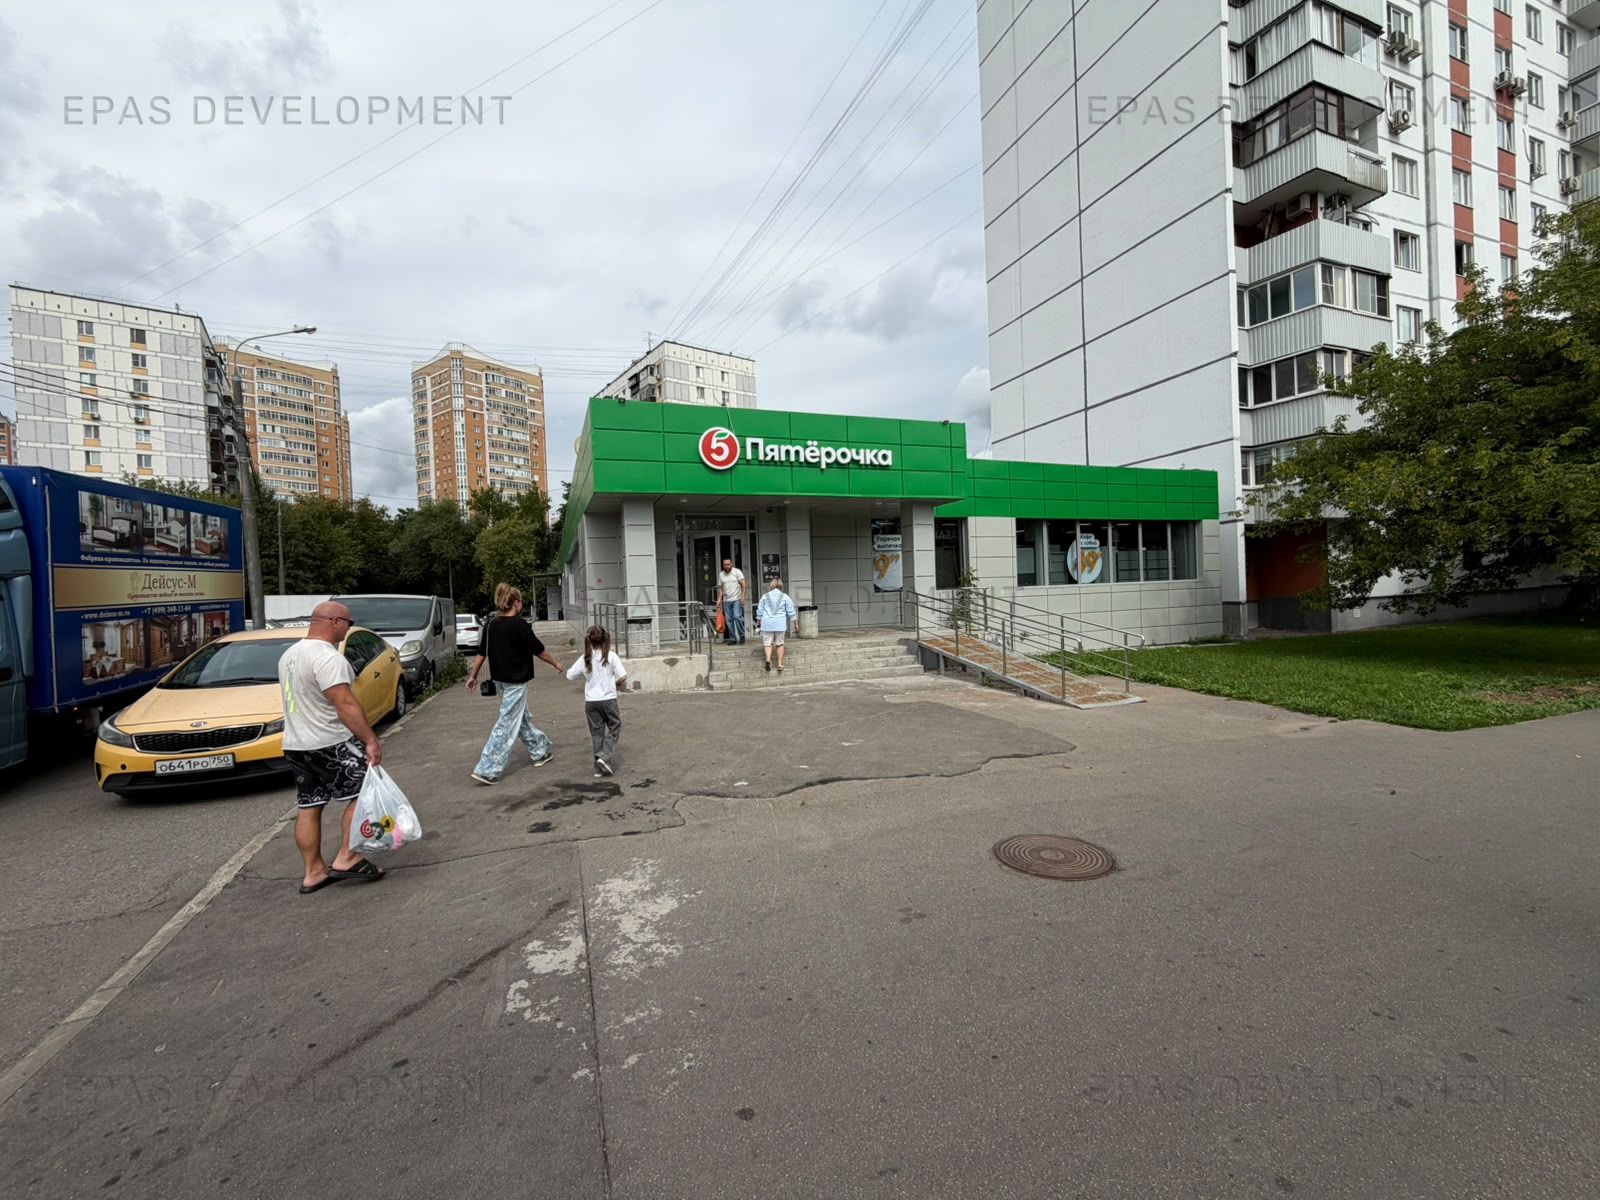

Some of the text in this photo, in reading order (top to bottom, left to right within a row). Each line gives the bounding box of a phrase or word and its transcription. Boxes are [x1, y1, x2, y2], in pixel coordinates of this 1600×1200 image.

[710, 430, 893, 469] 5 Пятёрочка
[141, 573, 197, 593] Дейсус-М
[212, 755, 229, 764] 750
